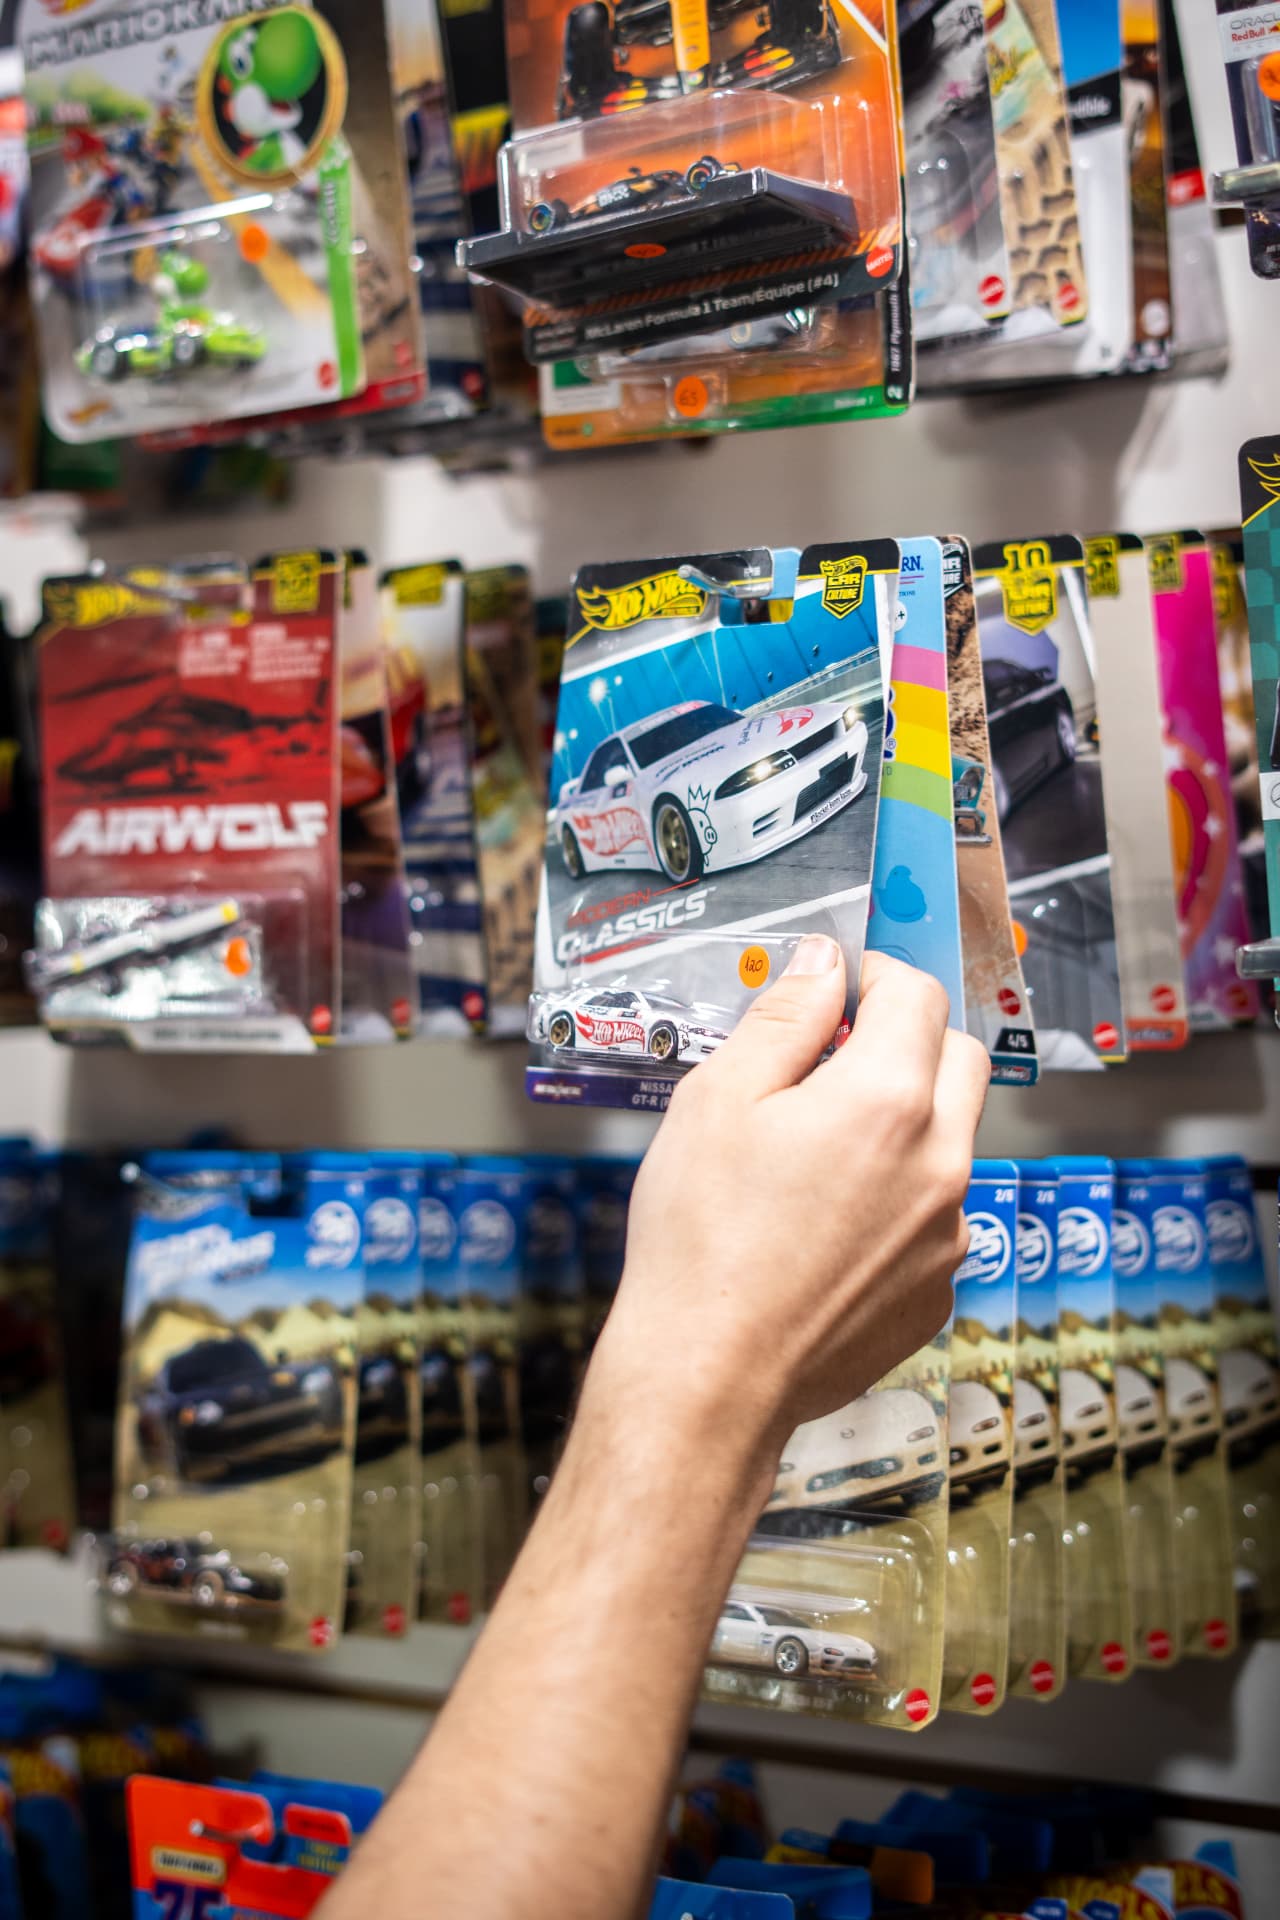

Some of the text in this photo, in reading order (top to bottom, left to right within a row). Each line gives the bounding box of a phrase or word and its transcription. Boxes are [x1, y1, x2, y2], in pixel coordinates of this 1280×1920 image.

[865, 252, 894, 273] MATTEL
[646, 303, 702, 328] Formula
[703, 301, 713, 316] 1
[712, 281, 807, 312] Team/Équipe
[807, 271, 840, 292] (#4)
[889, 293, 902, 344] Plymouth
[53, 801, 328, 857] AIRWOLF
[556, 886, 709, 962] CLASSICS
[631, 1094, 658, 1107] GT-R
[639, 1080, 676, 1094] NISSA
